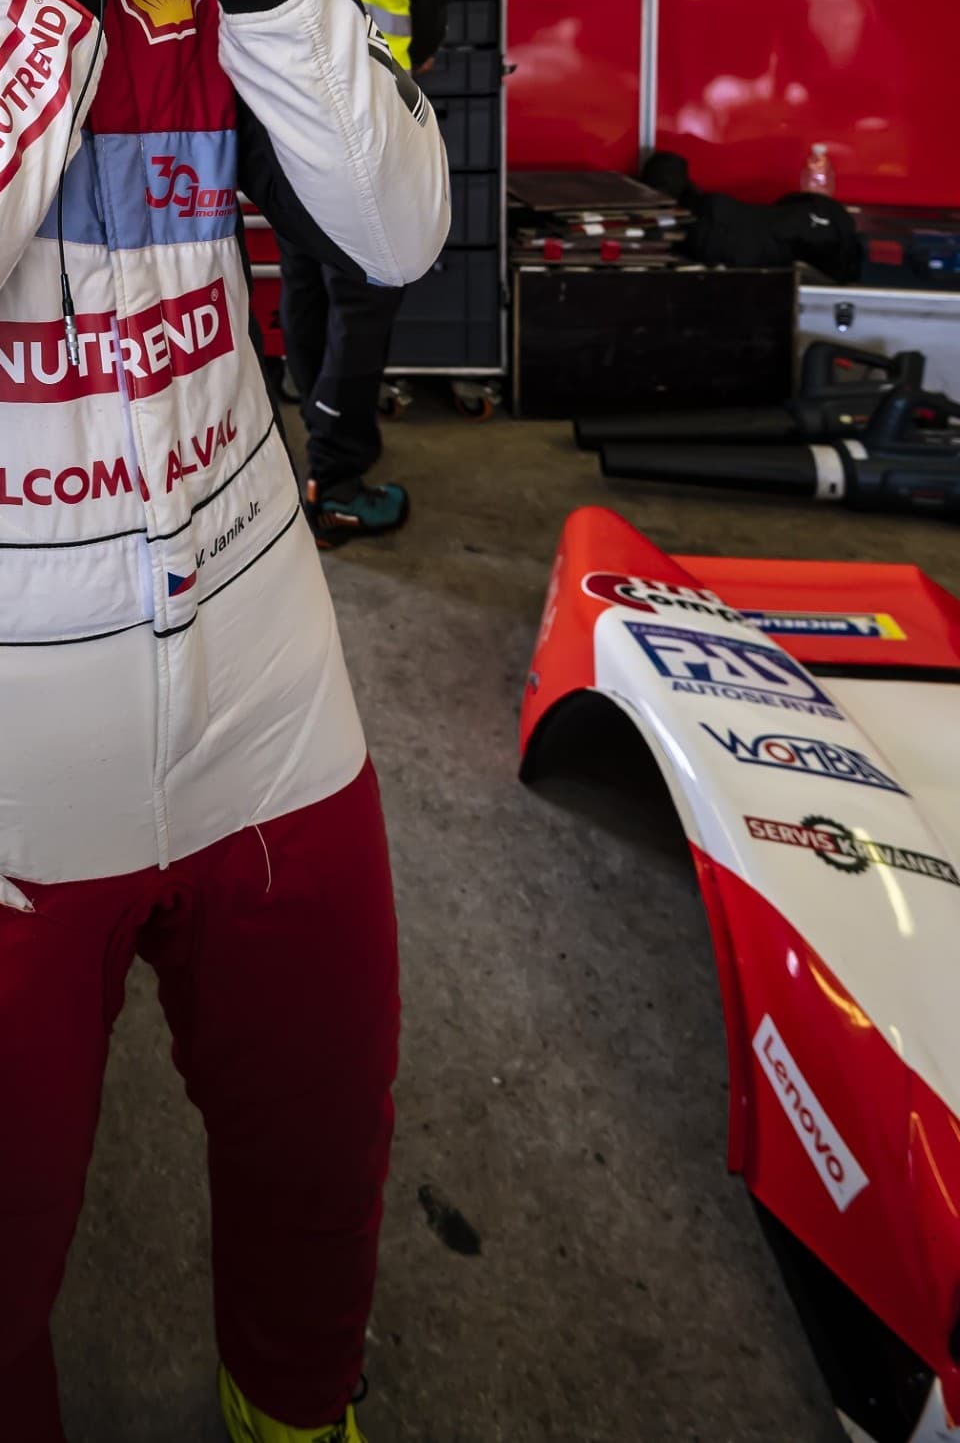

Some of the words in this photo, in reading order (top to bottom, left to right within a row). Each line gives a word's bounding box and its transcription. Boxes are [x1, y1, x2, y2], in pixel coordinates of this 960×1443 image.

[178, 185, 236, 218] Jan
[195, 548, 205, 569] V.
[210, 516, 245, 558] Janik
[248, 501, 261, 522] Jr.
[672, 680, 846, 722] AUTOSERVIS
[749, 819, 835, 852] SERVIS
[762, 1034, 845, 1184] Lenovo
